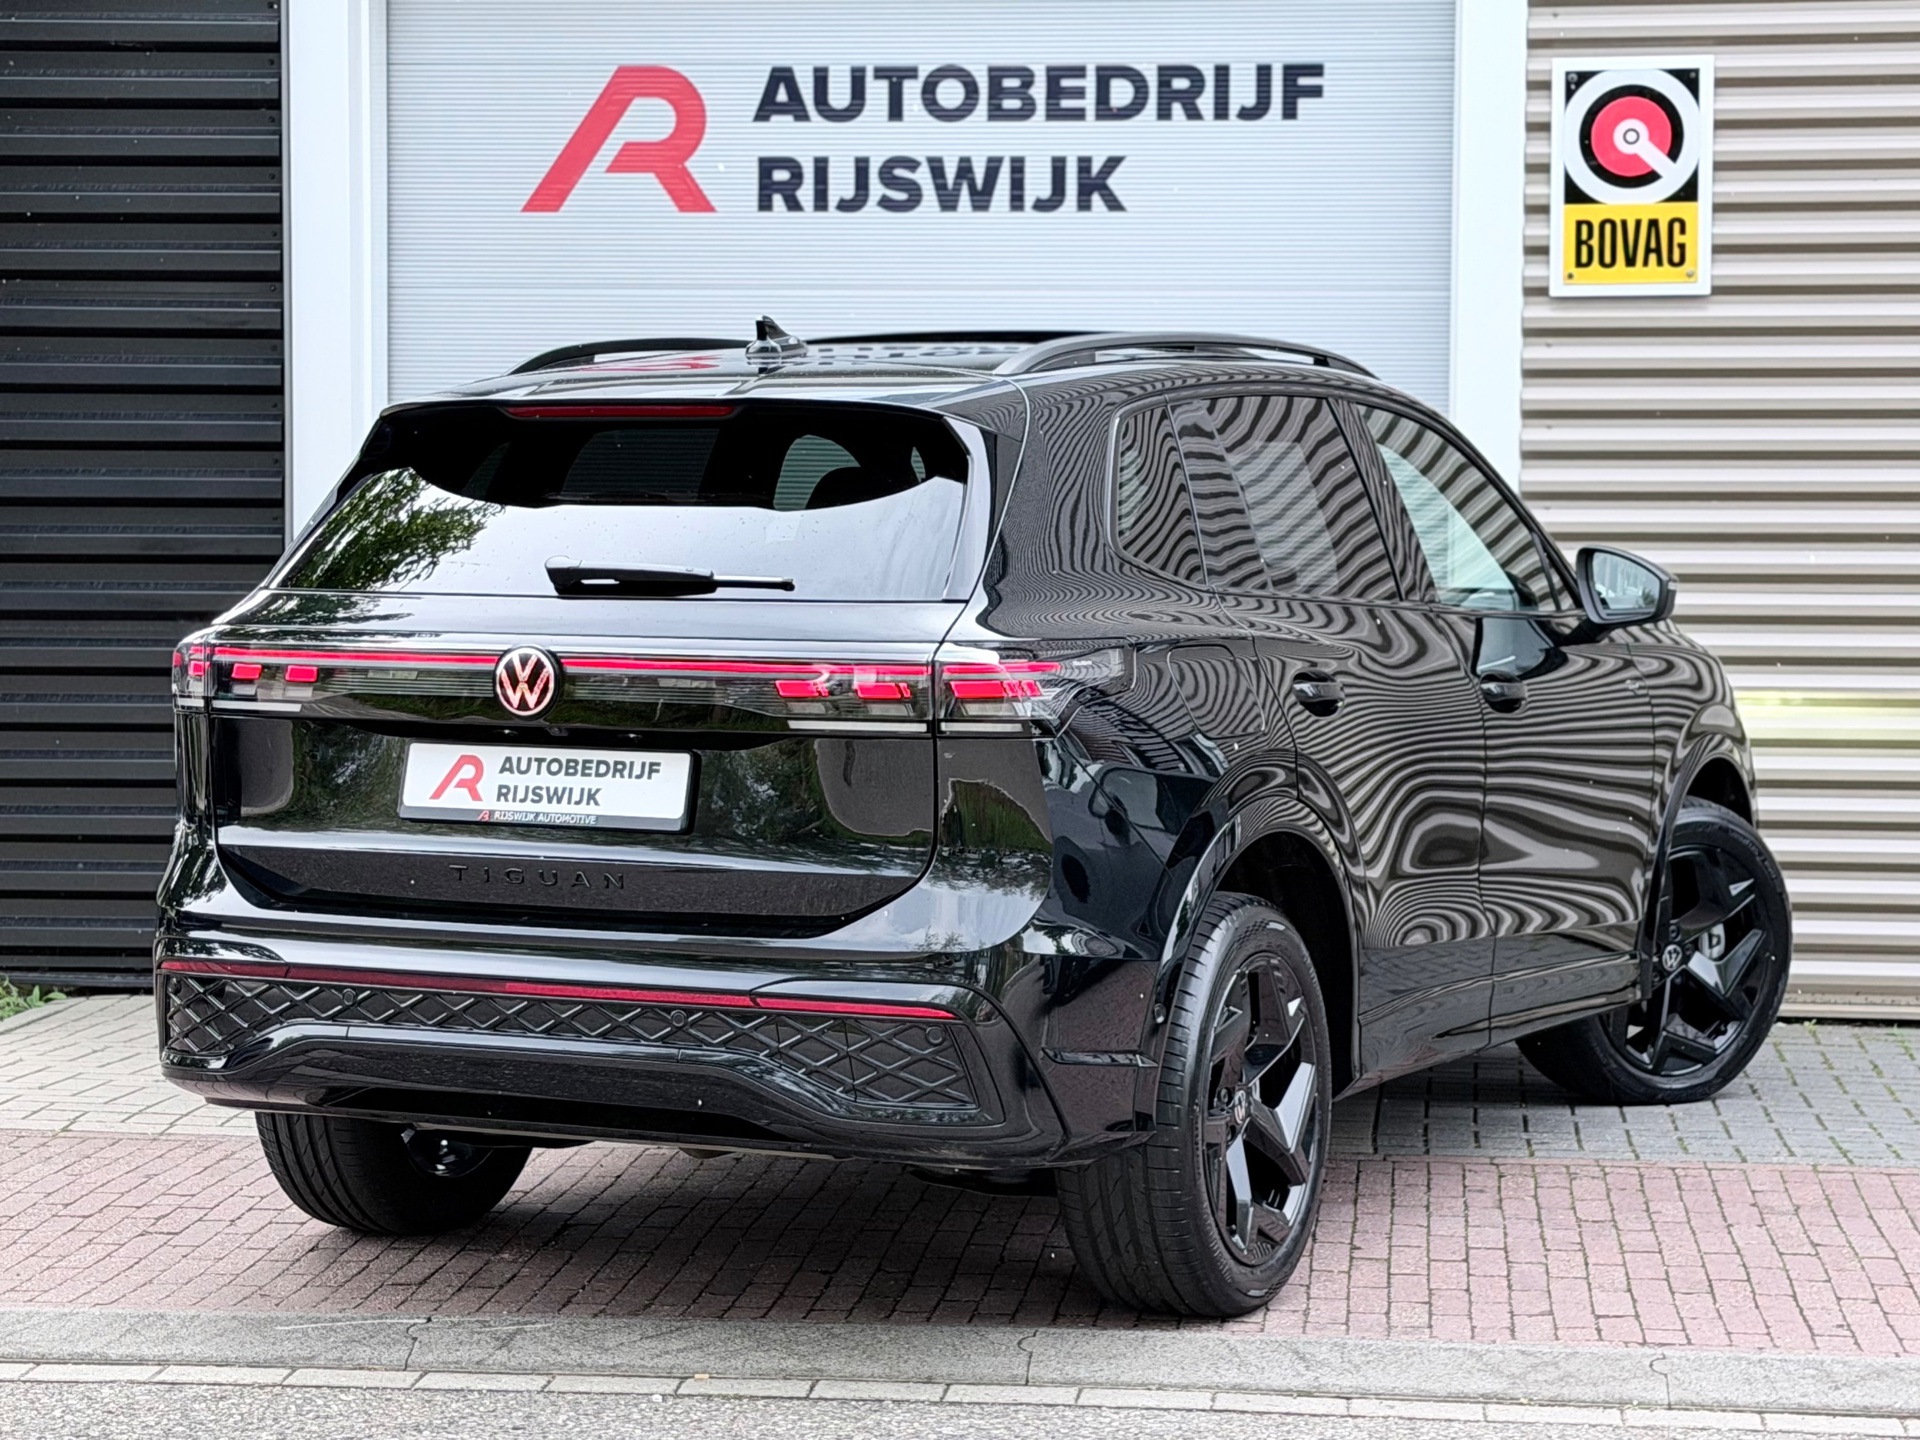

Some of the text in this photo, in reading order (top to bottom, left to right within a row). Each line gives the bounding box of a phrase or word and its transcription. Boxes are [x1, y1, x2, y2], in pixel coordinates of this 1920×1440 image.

[753, 63, 1324, 122] AUTOBEDRIJF
[757, 155, 1126, 212] RIJSWIJK
[1575, 217, 1686, 268] BOVAG
[498, 756, 662, 780] AUTOBEDRIJF
[496, 784, 602, 806] RIJSWIJK
[494, 811, 597, 825] RIJSWIJK AUTOMOTIVE
[449, 864, 625, 889] TIGUAN
